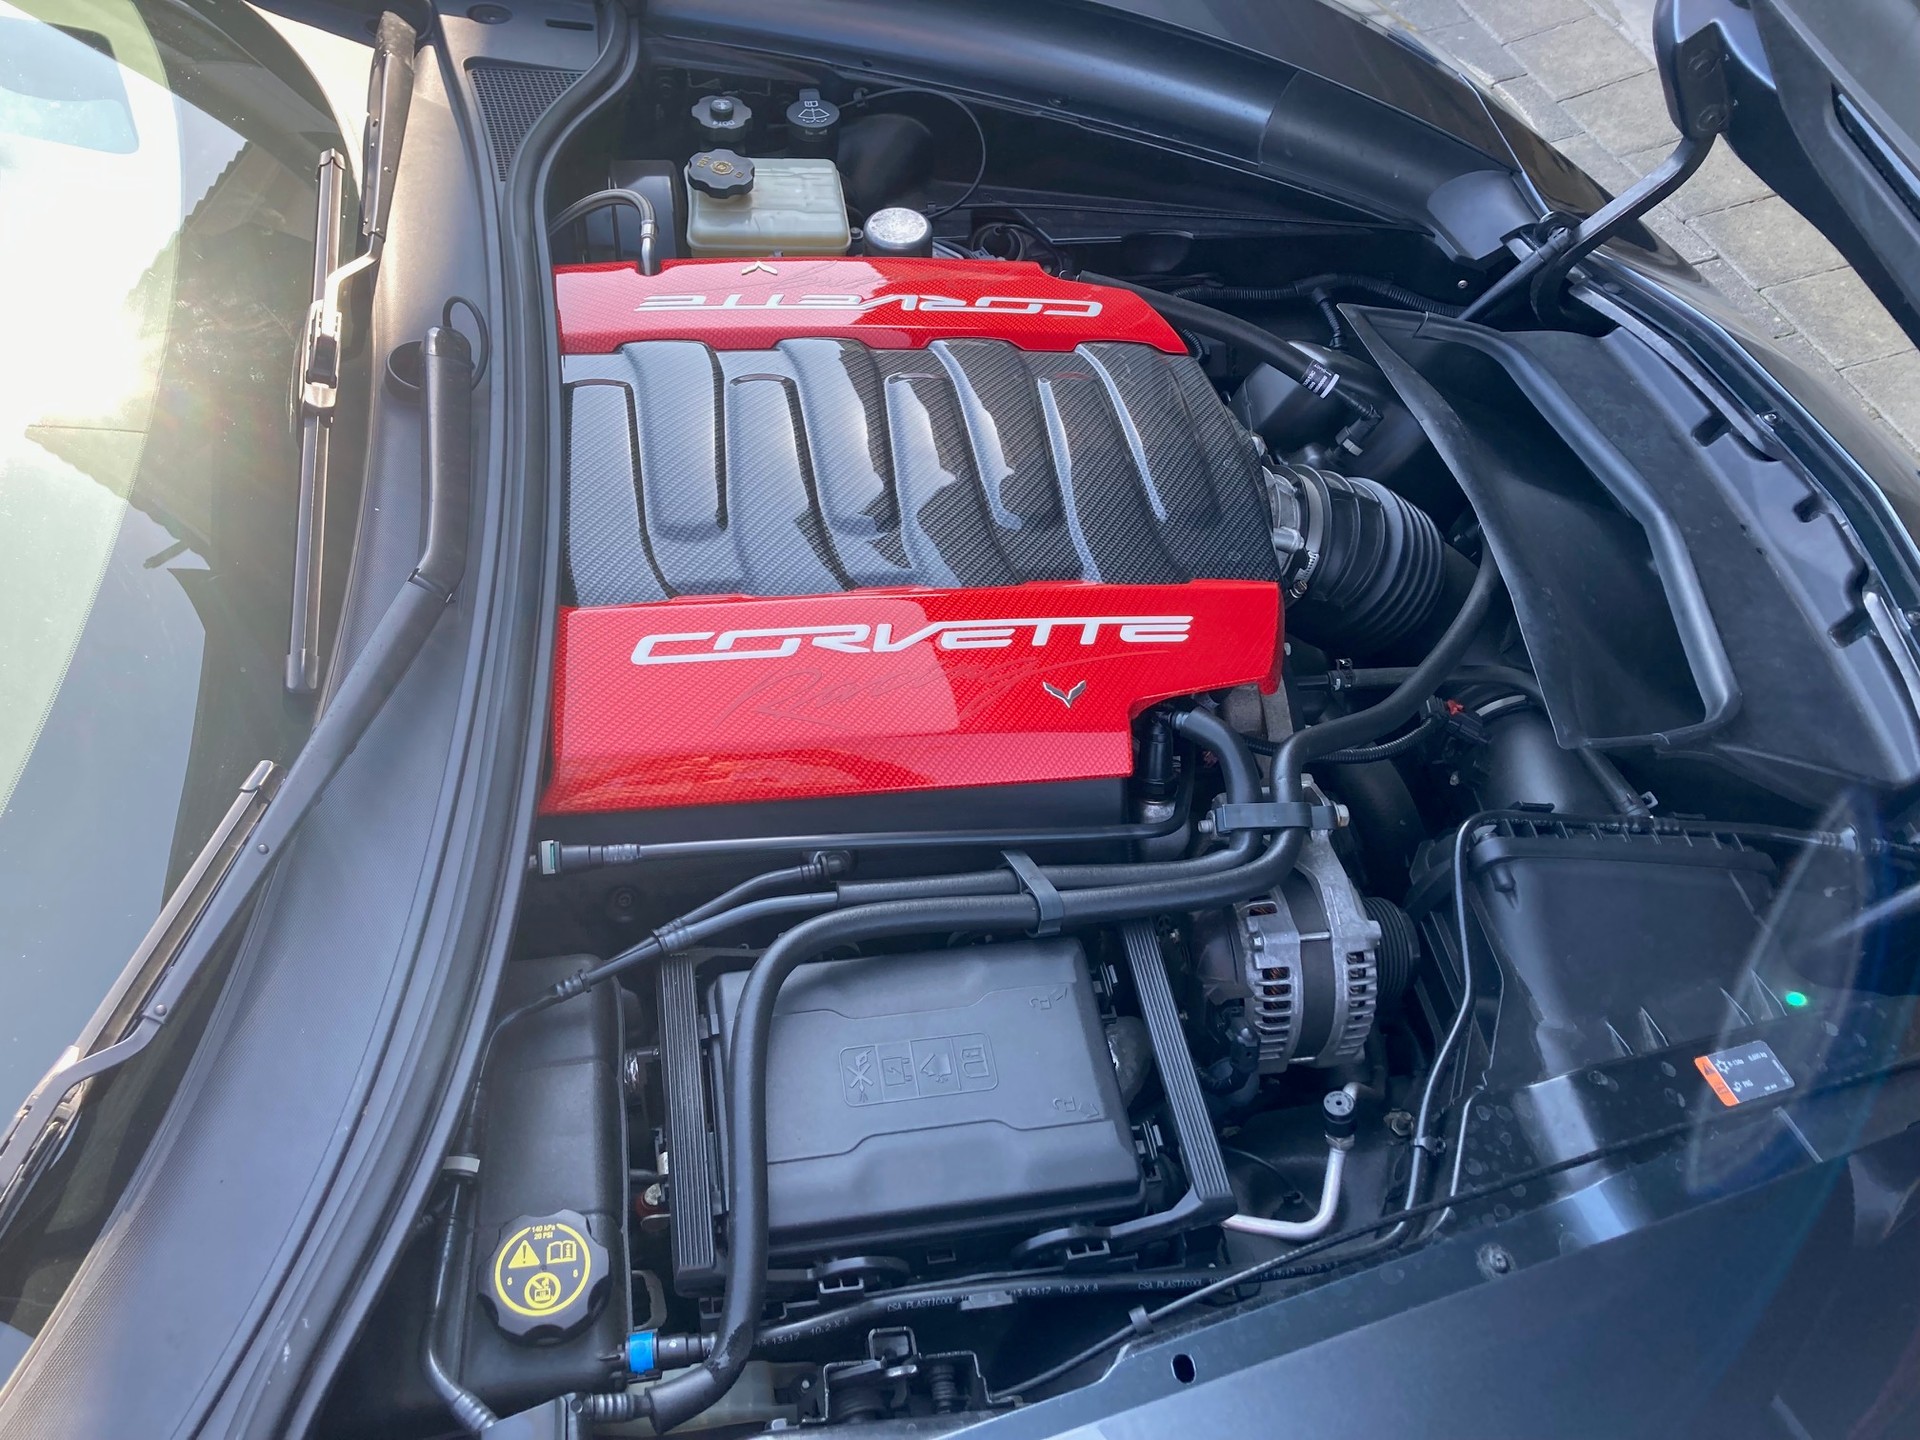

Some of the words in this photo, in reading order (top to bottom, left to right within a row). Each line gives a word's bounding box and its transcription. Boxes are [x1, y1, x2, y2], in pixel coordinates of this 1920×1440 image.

[636, 292, 1103, 318] CORVETTE
[630, 615, 1194, 665] CORVETTE
[532, 1225, 543, 1233] 140
[534, 1232, 543, 1240] 20
[543, 1231, 553, 1239] PSI
